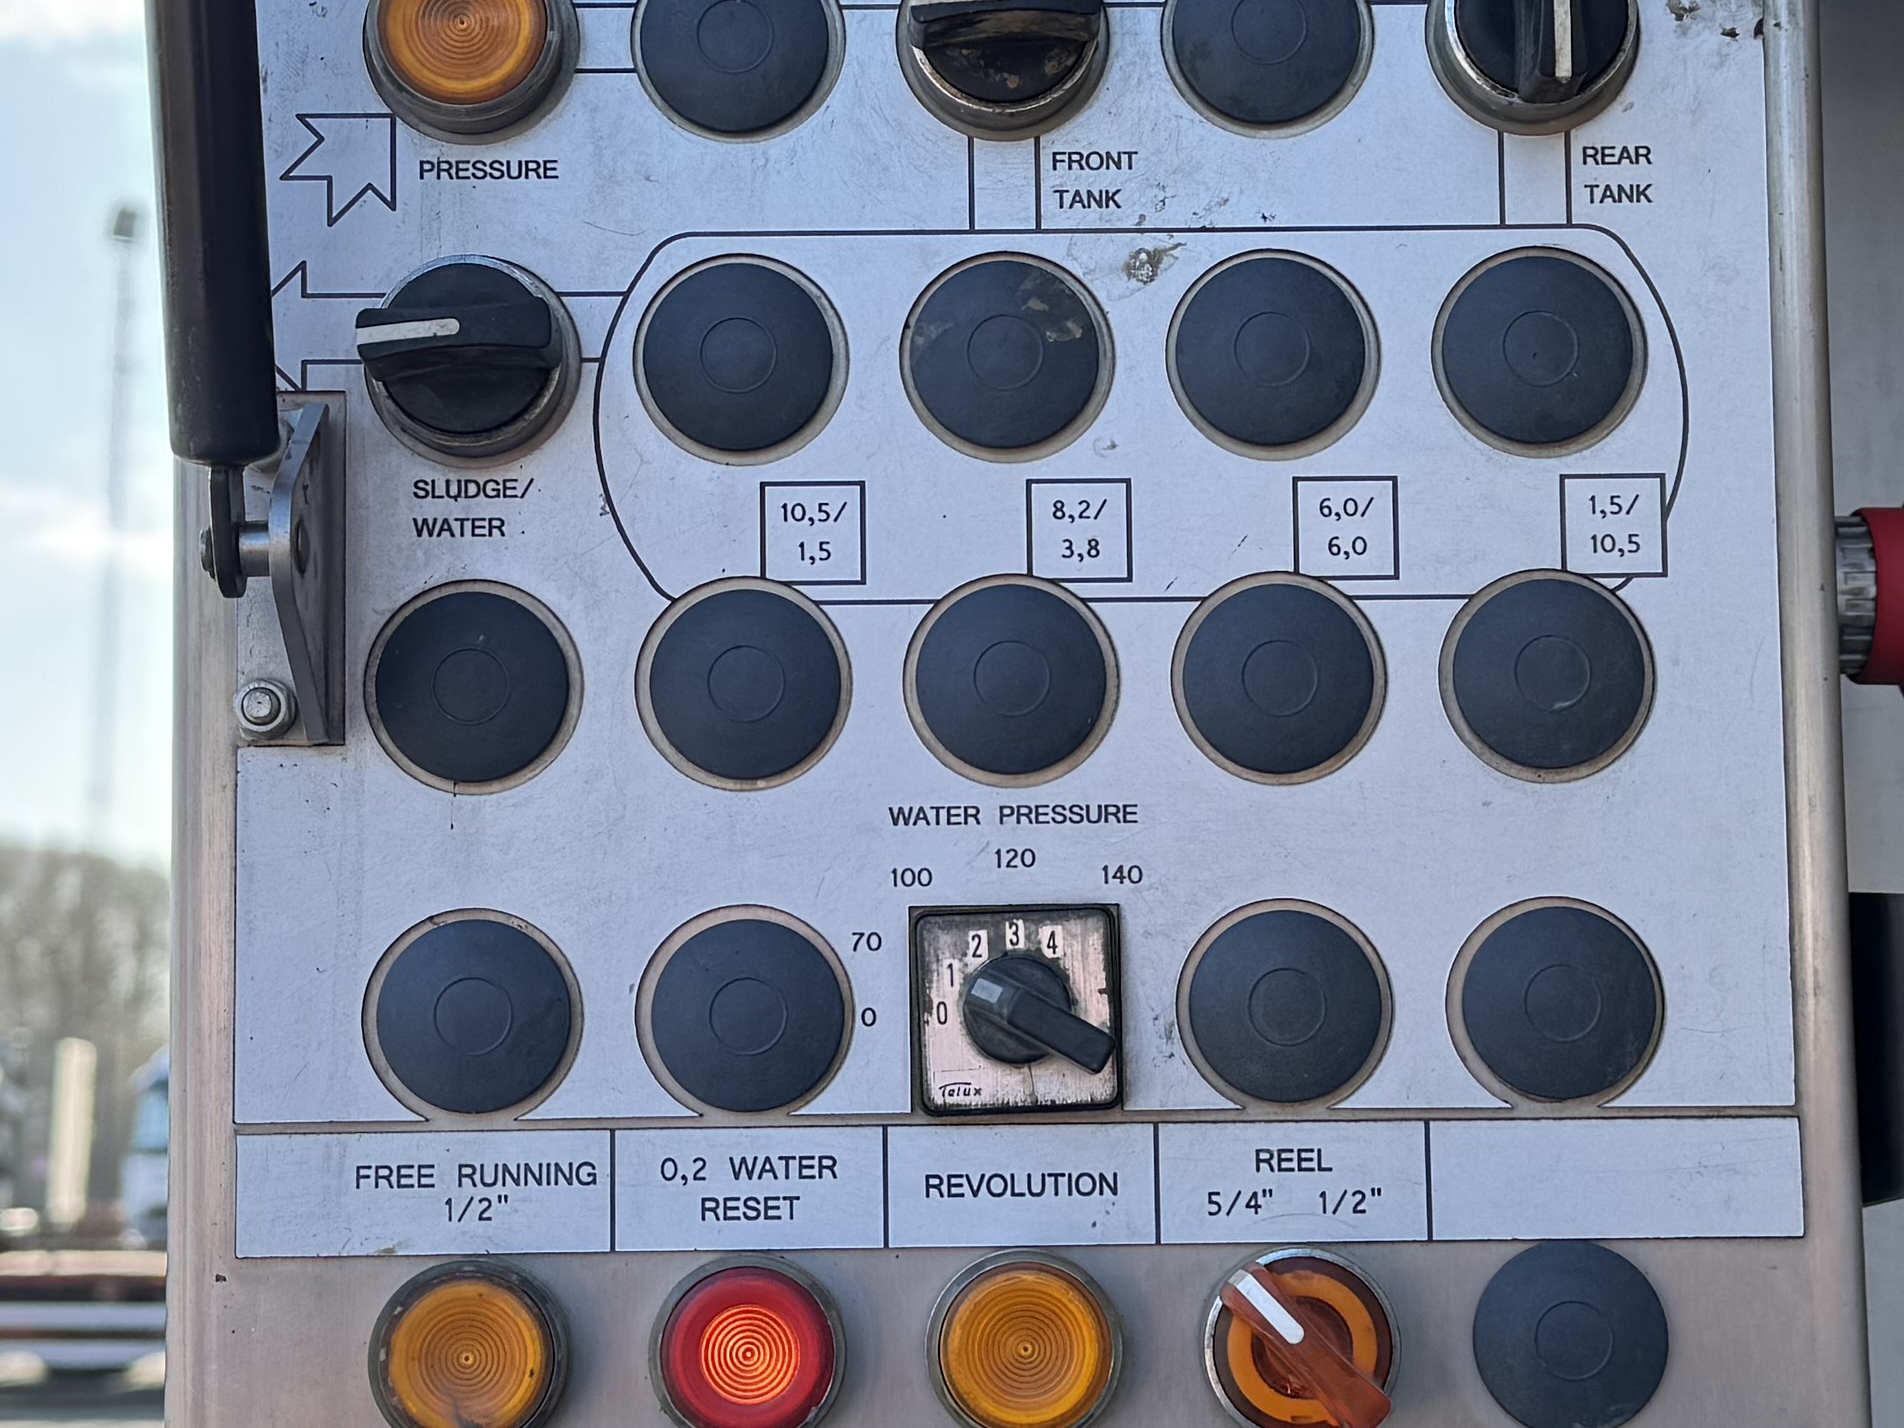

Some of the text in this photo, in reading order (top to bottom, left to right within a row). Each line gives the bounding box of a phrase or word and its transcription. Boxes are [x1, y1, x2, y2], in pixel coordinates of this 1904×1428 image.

[1051, 150, 1139, 172] FRONT
[1582, 145, 1653, 166] REAR
[419, 156, 560, 181] PRESSURE
[1052, 188, 1122, 210] TANK
[1583, 183, 1654, 205] TANK
[412, 477, 535, 503] SLUDGE/
[780, 501, 848, 527] 10,5/
[1052, 498, 1108, 524] 8,2/
[1319, 496, 1375, 522] 6,0/
[1588, 493, 1640, 519] 1,5/
[412, 517, 506, 538] WATER
[798, 540, 832, 566] 1,5
[1061, 538, 1100, 563] 3,8
[1327, 535, 1368, 561] 6,0
[1590, 533, 1641, 558] 10,5
[888, 803, 1139, 827] WATER PRESSURE
[994, 848, 1036, 869] 120
[891, 867, 933, 888] 100
[1101, 864, 1144, 885] 140
[851, 931, 882, 953] 70
[971, 934, 983, 958] 2
[1009, 923, 1019, 946] 3
[1046, 930, 1058, 955] 4
[946, 963, 955, 988] 1
[860, 1007, 877, 1028] 0
[936, 1002, 948, 1025] 0
[660, 1155, 838, 1187] 0,2 WATER
[1254, 1147, 1334, 1174] REEL
[355, 1160, 597, 1190] FREE RUNNING
[924, 1171, 1119, 1199] REVOLUTION
[444, 1194, 509, 1223] 1/2"
[700, 1195, 801, 1222] RESET
[1207, 1187, 1382, 1217] 5/4" 1/2"
